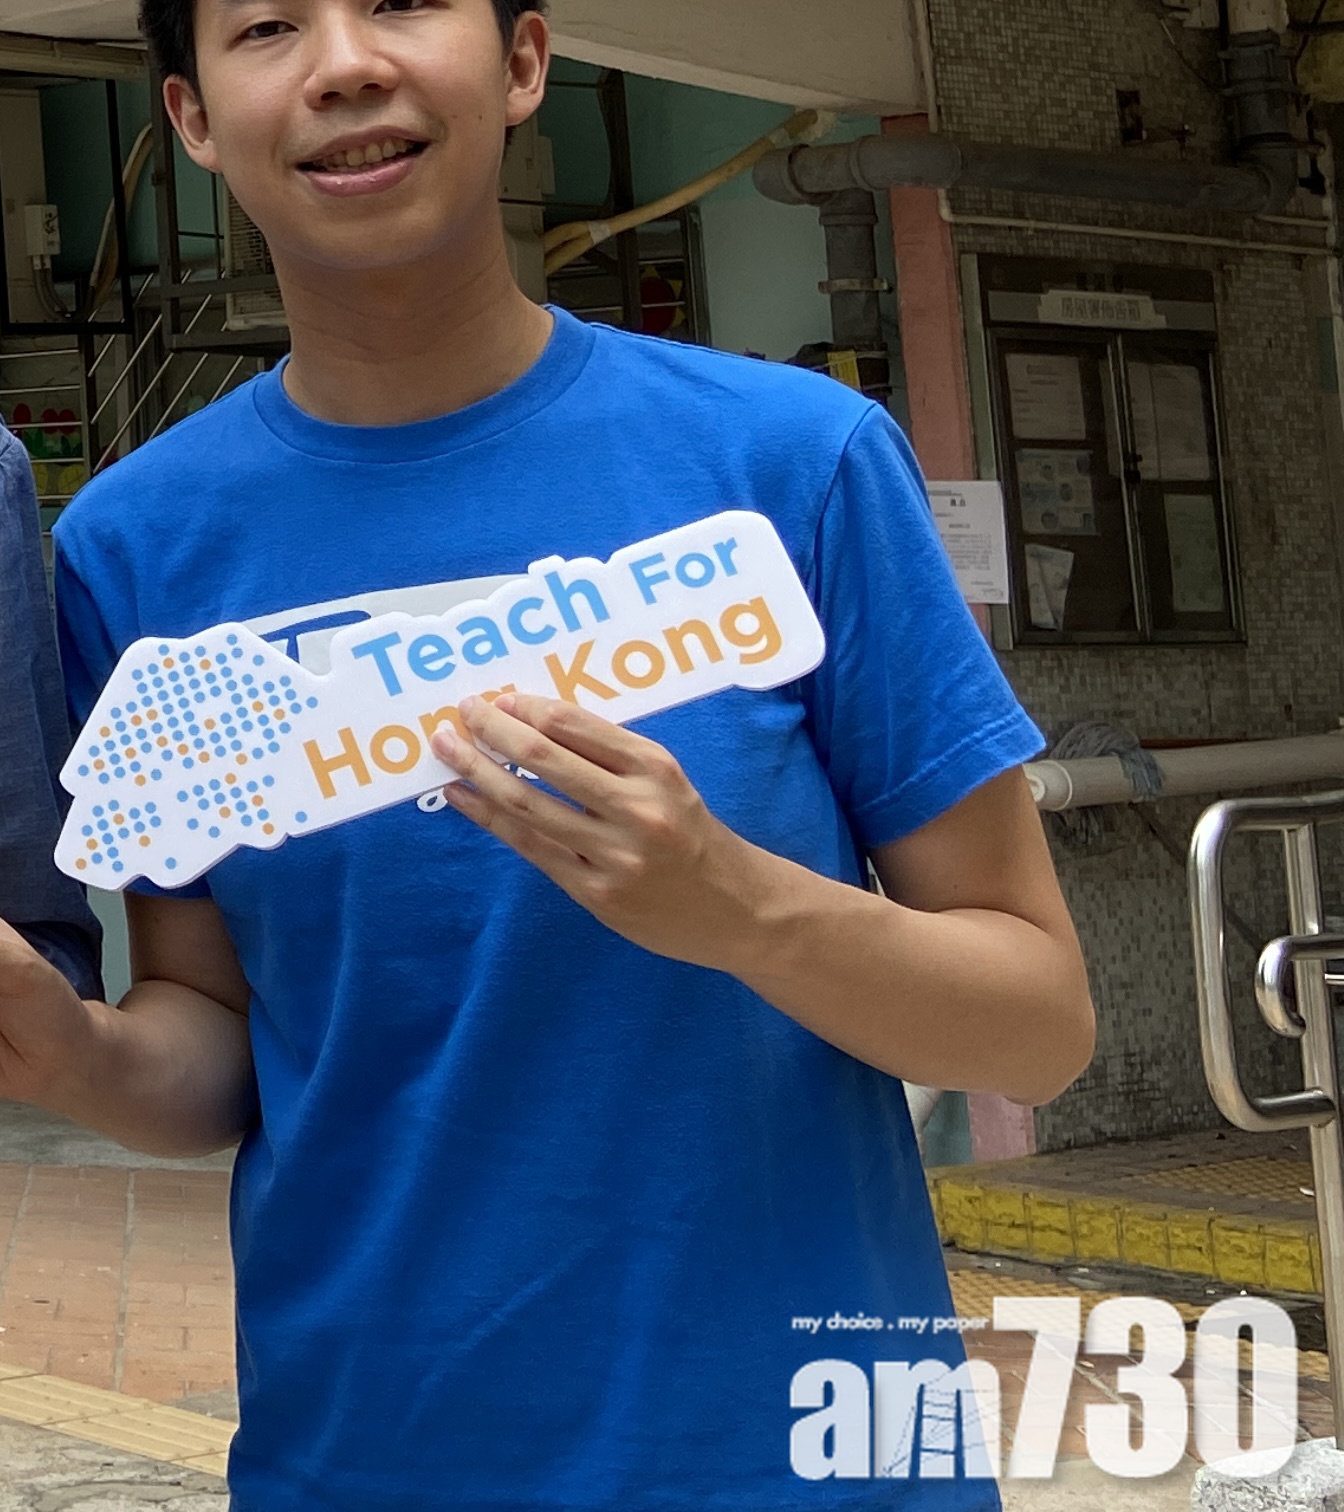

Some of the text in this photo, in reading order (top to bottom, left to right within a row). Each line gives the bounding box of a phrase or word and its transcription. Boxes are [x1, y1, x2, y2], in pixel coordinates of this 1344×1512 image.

[302, 684, 520, 799] Hon
[543, 596, 782, 705] Kong
[352, 536, 741, 697] Teach For
